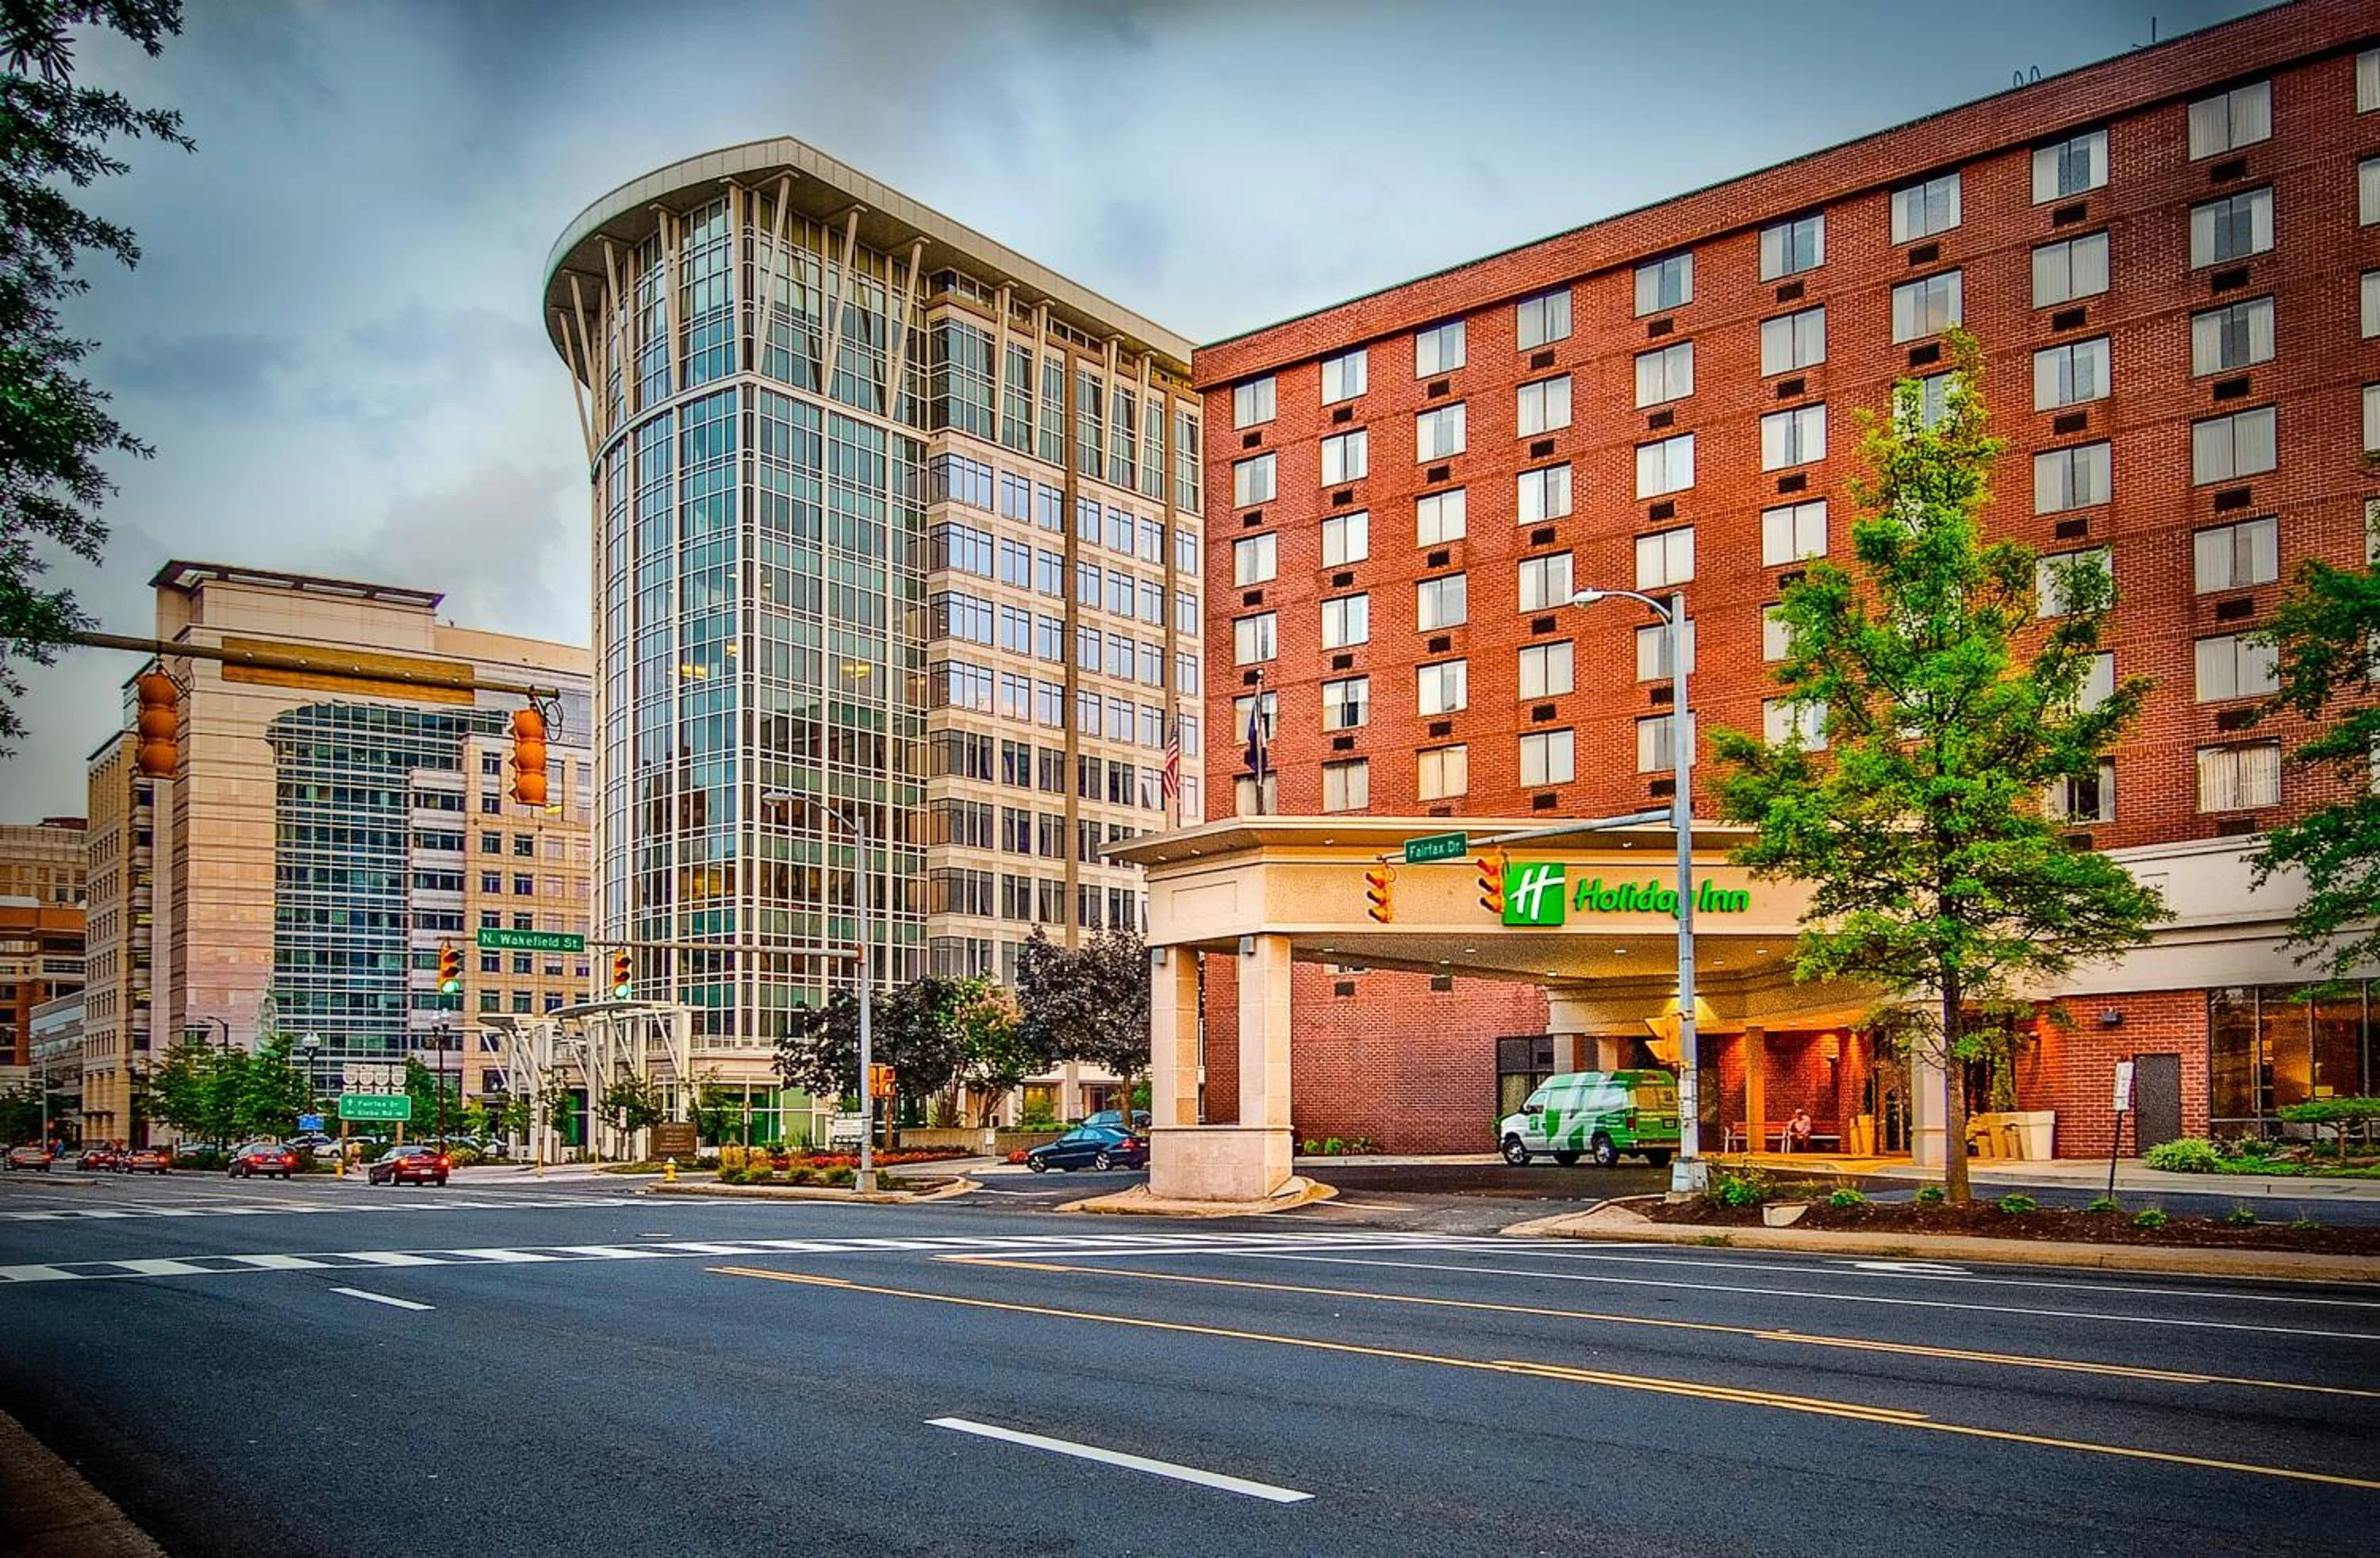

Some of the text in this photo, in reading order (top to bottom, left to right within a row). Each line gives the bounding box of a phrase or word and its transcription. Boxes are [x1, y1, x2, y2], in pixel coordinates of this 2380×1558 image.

[1409, 841, 1464, 858] Fairfax Dr.
[1699, 878, 1749, 912] Inn
[482, 932, 582, 950] N. Wakefield St.
